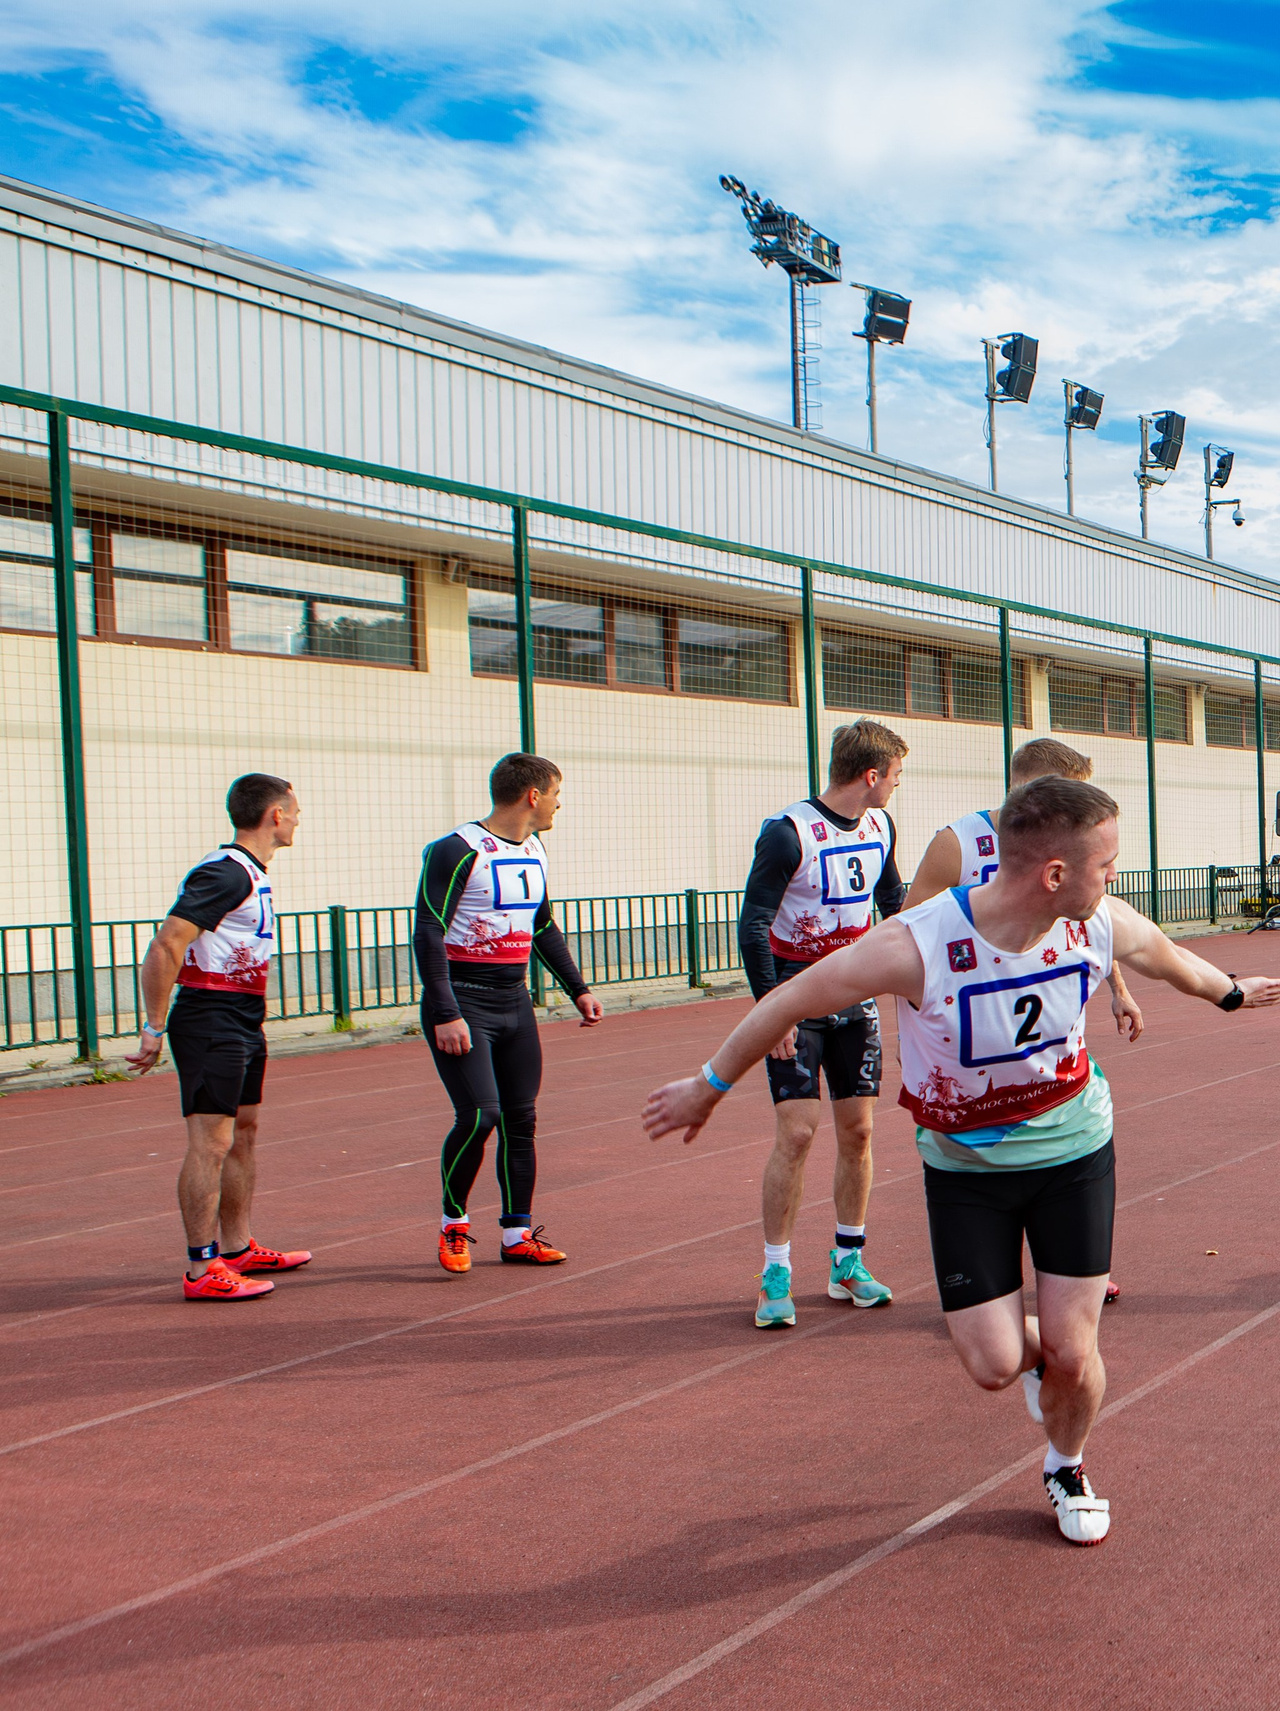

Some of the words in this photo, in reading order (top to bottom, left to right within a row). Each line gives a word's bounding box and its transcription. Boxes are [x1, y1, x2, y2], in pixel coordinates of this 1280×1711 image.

[517, 869, 530, 900] 1
[847, 856, 866, 892] 3
[1013, 993, 1044, 1048] 2
